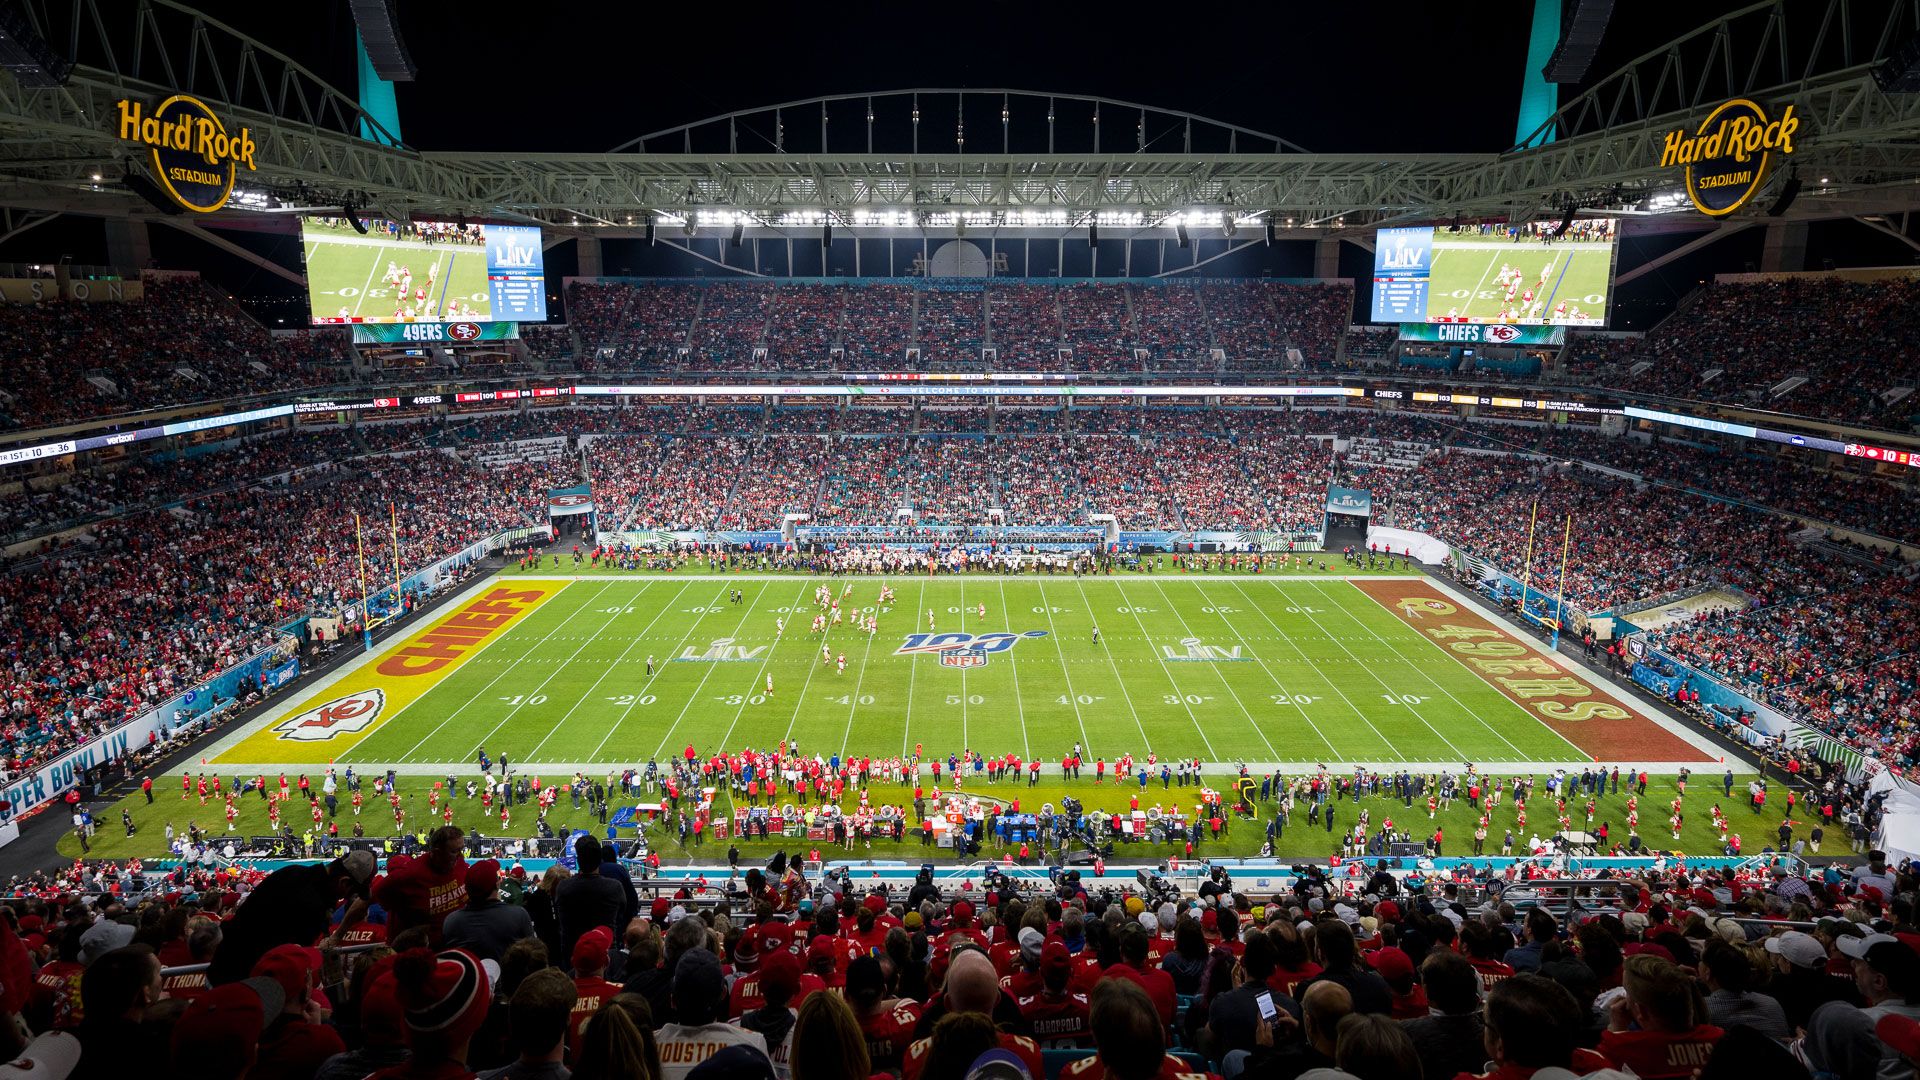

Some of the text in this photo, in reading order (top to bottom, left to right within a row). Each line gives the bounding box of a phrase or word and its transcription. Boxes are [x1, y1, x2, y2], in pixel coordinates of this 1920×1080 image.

[118, 99, 257, 171] Hard Rock
[1661, 105, 1799, 168] Hard Rock
[172, 168, 221, 186] STADIUM
[1699, 171, 1750, 189] STADIUM
[495, 245, 535, 265] LIV
[1384, 247, 1424, 266] LIV
[403, 324, 443, 341] 49ERS
[1438, 324, 1480, 341] CHIEFS
[413, 396, 442, 405] 49ERS
[482, 392, 495, 400] 109
[1374, 390, 1403, 399] CHIEFS
[187, 414, 235, 430] WELCOME
[240, 412, 252, 421] TO
[1680, 416, 1705, 428] BOWL
[1711, 421, 1729, 431] LIV
[106, 432, 136, 446] verizon
[10, 451, 24, 461] 1ST
[31, 448, 42, 457] 10
[57, 443, 70, 453] 36
[1883, 449, 1897, 462] 10
[376, 587, 546, 677] CHIEFS
[1631, 640, 1643, 655] 40
[945, 656, 982, 666] NFL
[1425, 624, 1635, 722] 49ERS
[506, 694, 547, 705] 10
[614, 694, 657, 705] 20
[725, 694, 766, 705] 30
[834, 694, 875, 705] 40
[945, 694, 984, 705] 50
[1055, 694, 1093, 705] 40
[1163, 694, 1203, 705] 30
[1271, 694, 1312, 705] 20
[1380, 694, 1422, 705] 10
[103, 730, 127, 763] LIV
[428, 878, 459, 897] TRAVIS
[342, 930, 374, 942] ZALEZ
[171, 973, 208, 989] THOMA
[571, 995, 600, 1013] HENS
[1033, 1016, 1082, 1035] GAROPPOLO
